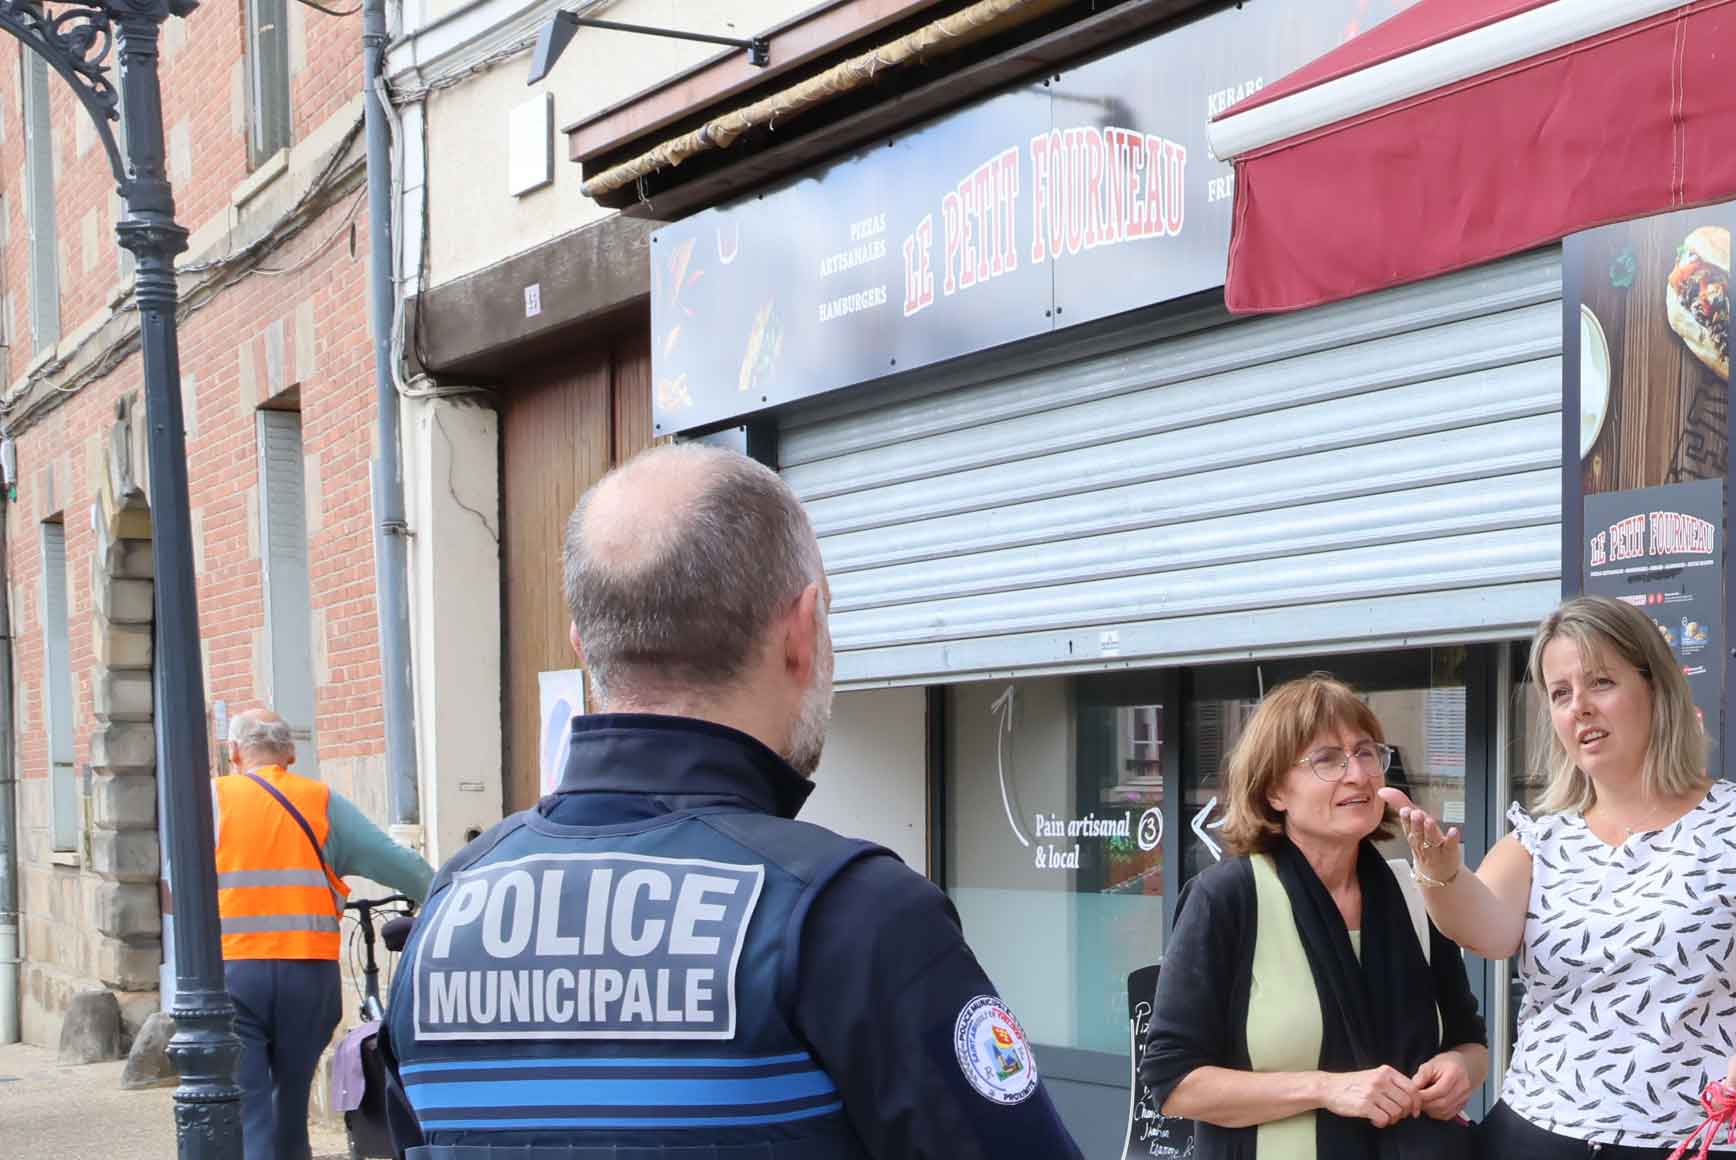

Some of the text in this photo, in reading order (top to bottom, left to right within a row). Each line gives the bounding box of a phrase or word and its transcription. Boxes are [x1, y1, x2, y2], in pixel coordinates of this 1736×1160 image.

[1207, 174, 1235, 203] FRI
[903, 126, 1186, 317] LE PETIT FOURNEAU
[818, 284, 888, 322] HAMBURGERS
[1590, 511, 1716, 567] LE PETIT FOURNEAU
[1035, 813, 1065, 837] Pain
[1067, 811, 1131, 838] artisanal
[1035, 844, 1080, 869] & local
[432, 869, 740, 959] POLICE
[429, 968, 715, 1024] MUNICIPALE
